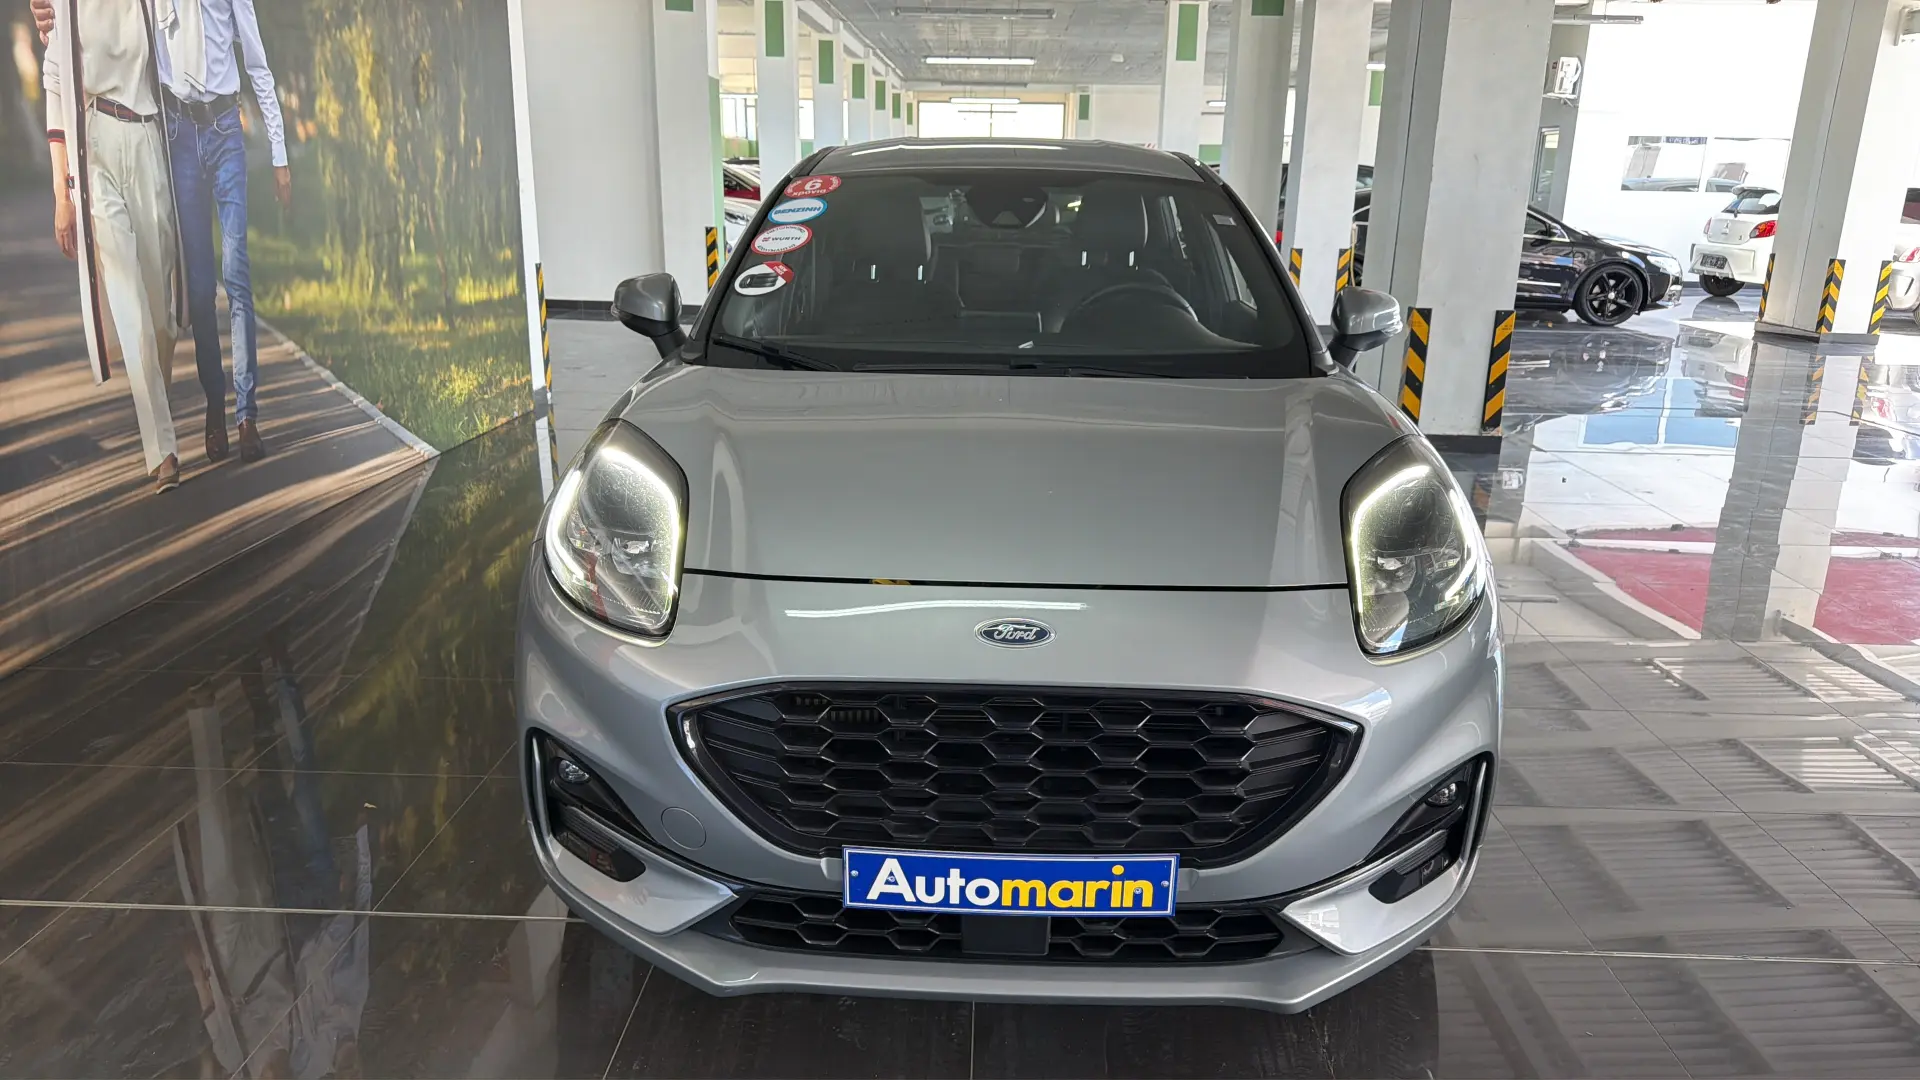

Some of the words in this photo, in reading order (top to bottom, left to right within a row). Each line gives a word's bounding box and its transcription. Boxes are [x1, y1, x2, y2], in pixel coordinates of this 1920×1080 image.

[804, 179, 823, 191] 6
[983, 623, 1041, 640] Ford
[866, 858, 1153, 908] Automarin
